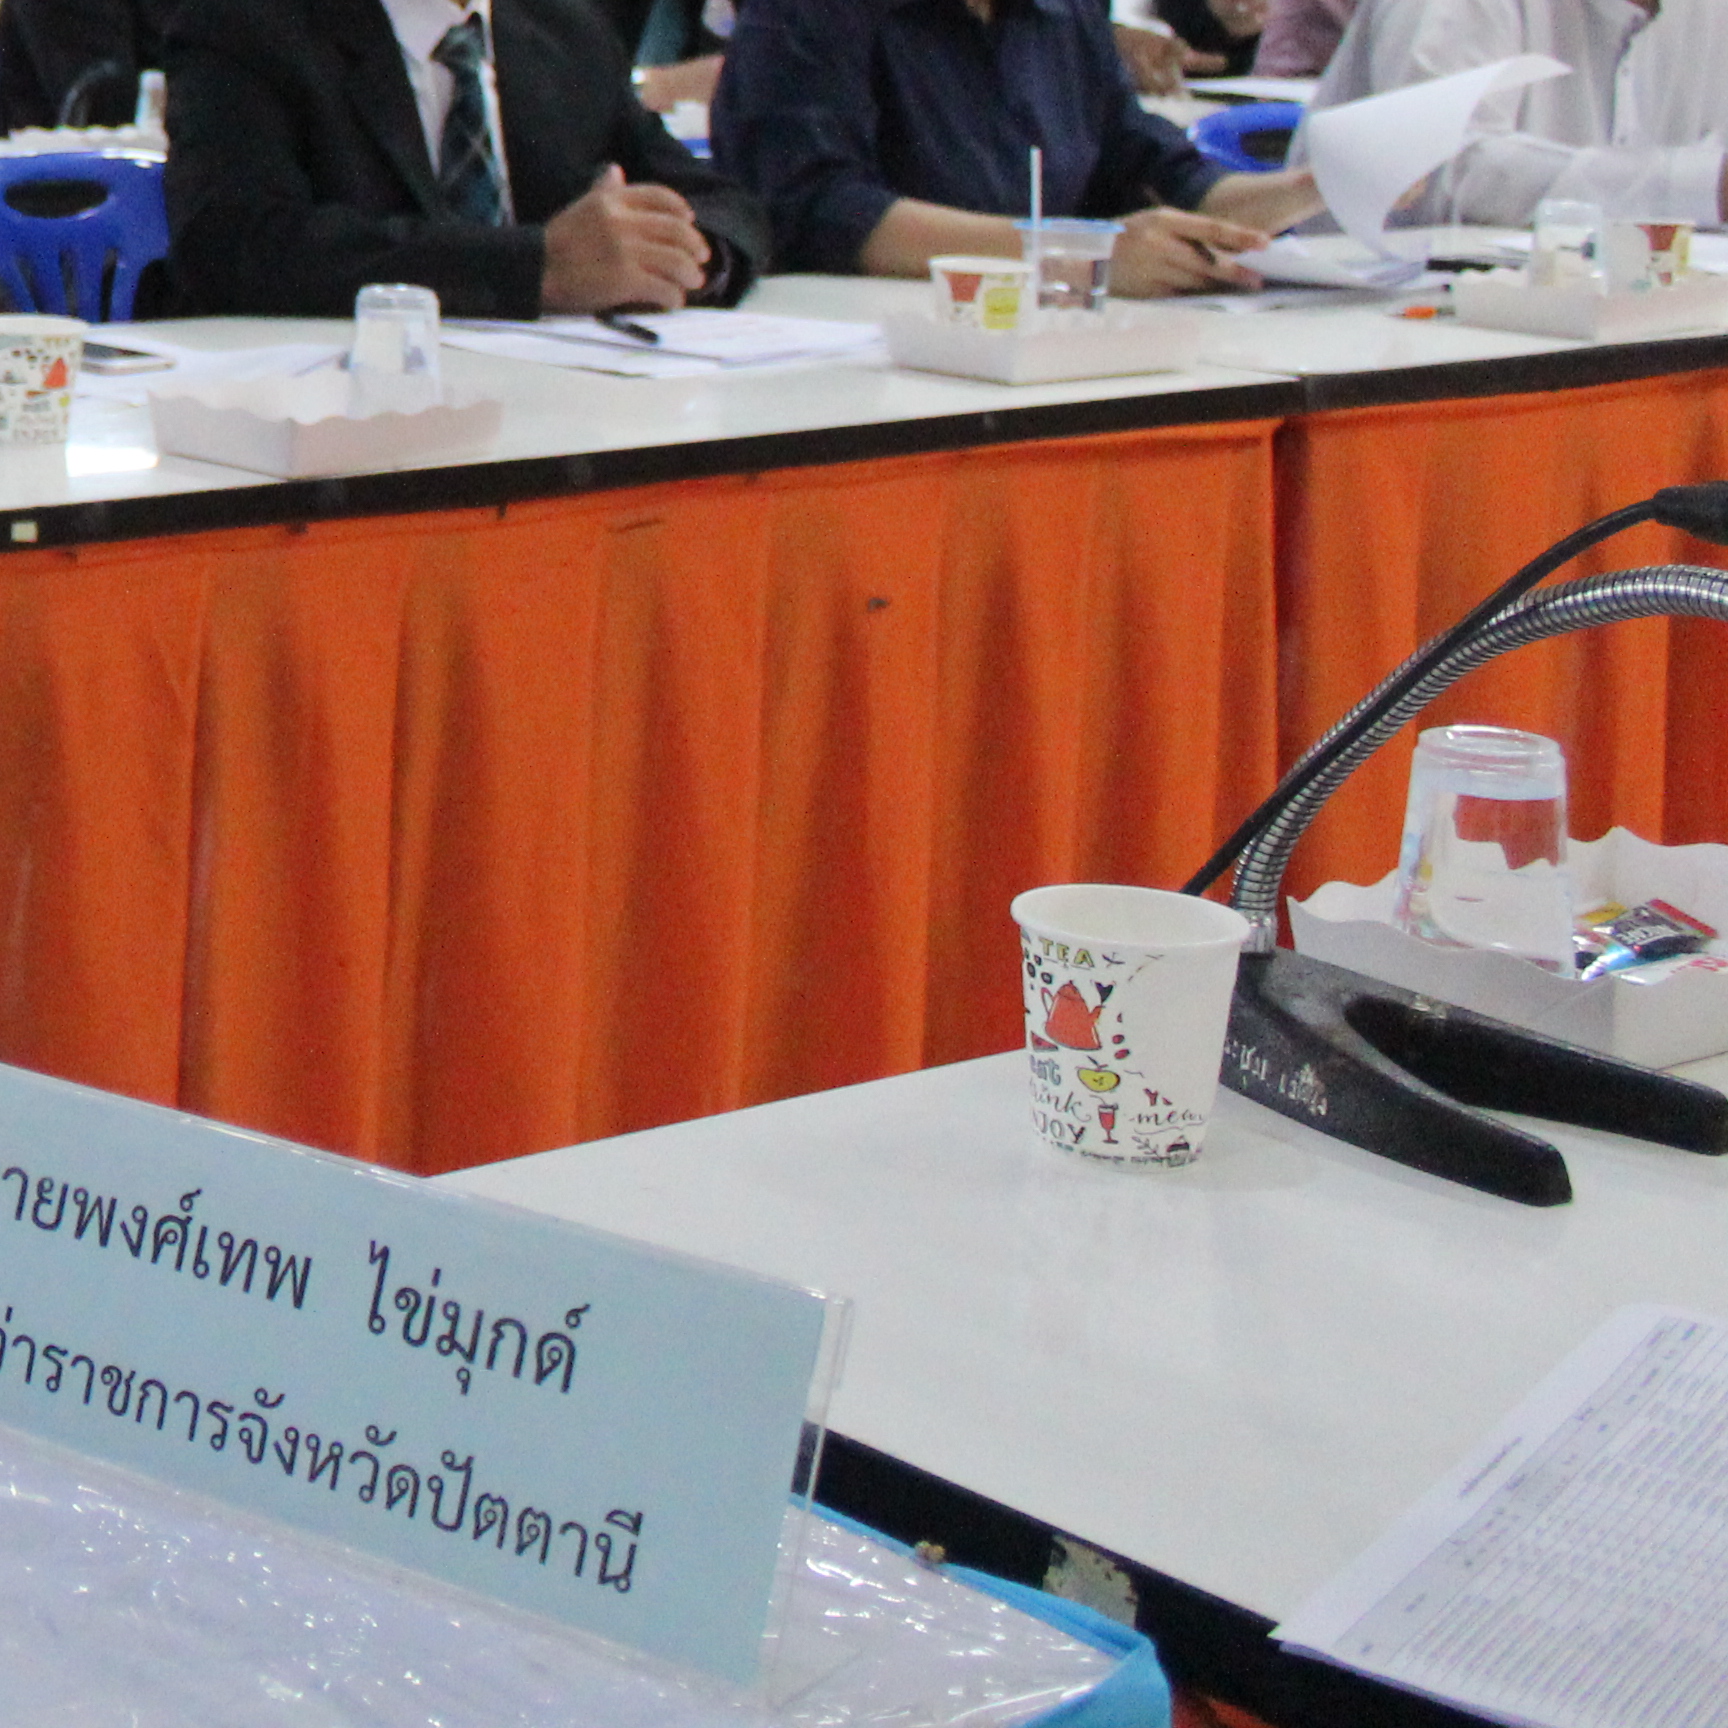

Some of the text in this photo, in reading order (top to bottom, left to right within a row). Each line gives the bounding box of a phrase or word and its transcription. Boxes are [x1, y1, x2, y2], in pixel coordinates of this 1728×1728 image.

[1039, 937, 1095, 969] TEA
[367, 1239, 592, 1396] ไข่มุกด์
